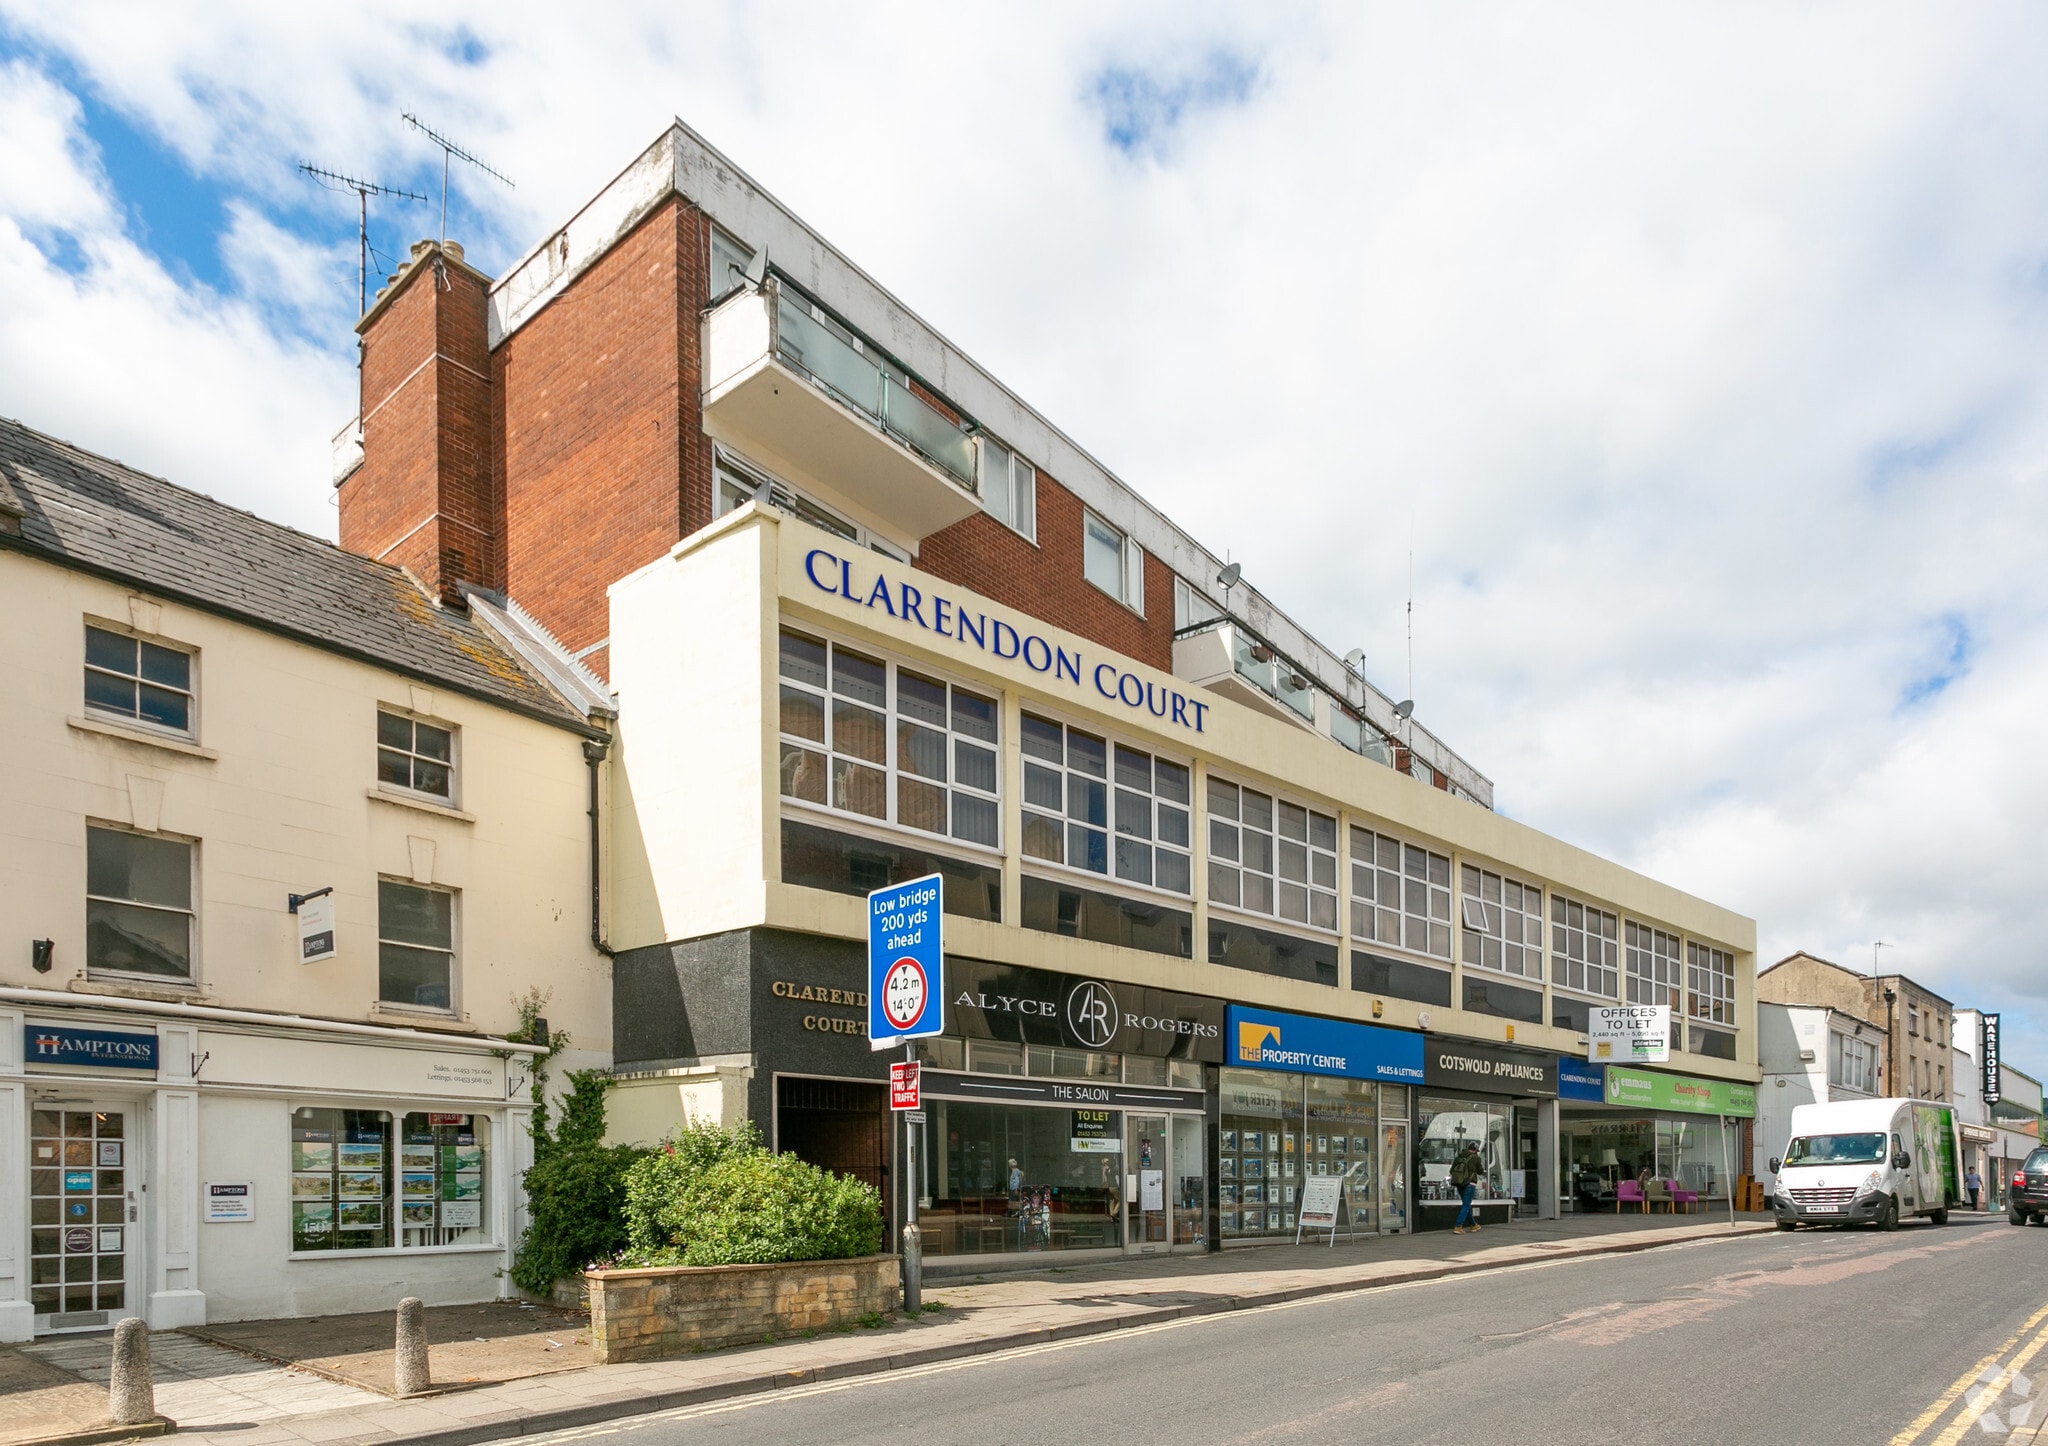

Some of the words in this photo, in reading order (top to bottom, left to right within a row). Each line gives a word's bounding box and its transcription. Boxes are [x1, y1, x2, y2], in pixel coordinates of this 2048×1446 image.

[805, 549, 1082, 687] CLARENDON
[1094, 663, 1209, 734] COURT
[874, 899, 896, 915] Low
[899, 888, 937, 909] bridge
[881, 912, 905, 932] 200
[907, 908, 928, 929] yds
[887, 928, 922, 950] ahead
[890, 977, 909, 991] 4.2
[911, 978, 920, 989] m
[772, 981, 868, 1007] CLAREND
[953, 991, 1057, 1018] ALYCE
[1123, 1013, 1218, 1038] ROGERS
[1600, 1007, 1657, 1018] OFFICES
[803, 1015, 868, 1036] COURT
[1605, 1019, 1623, 1030] TO
[1627, 1019, 1652, 1029] LET
[36, 1034, 151, 1056] HAMPTONS
[91, 1052, 151, 1061] INTERNATIONAL
[1240, 1046, 1261, 1061] THE
[1262, 1049, 1312, 1065] PROPERTY
[1312, 1055, 1347, 1070] CENTRE
[1984, 1016, 1998, 1092] WAREHOUSE
[892, 1070, 905, 1080] KEEP
[905, 1067, 918, 1079] LEFT
[1377, 1065, 1393, 1074] SALES
[1393, 1067, 1399, 1075] &
[1399, 1067, 1424, 1078] LETTINGS
[1439, 1054, 1491, 1075] COTSWOLD
[1493, 1062, 1544, 1082] APPLIANCES
[893, 1081, 905, 1092] TWO
[1560, 1074, 1587, 1084] CLARENDON
[1586, 1078, 1601, 1086] COURT
[1621, 1077, 1652, 1090] emmaus
[894, 1092, 916, 1103] TRAFFIC
[1052, 1085, 1072, 1099] THE
[1075, 1087, 1109, 1101] SALON
[1674, 1082, 1696, 1098] Charity
[1697, 1085, 1711, 1100] Shop
[1077, 1110, 1090, 1121] TO
[1092, 1111, 1110, 1121] LET
[67, 1177, 91, 1185] open
